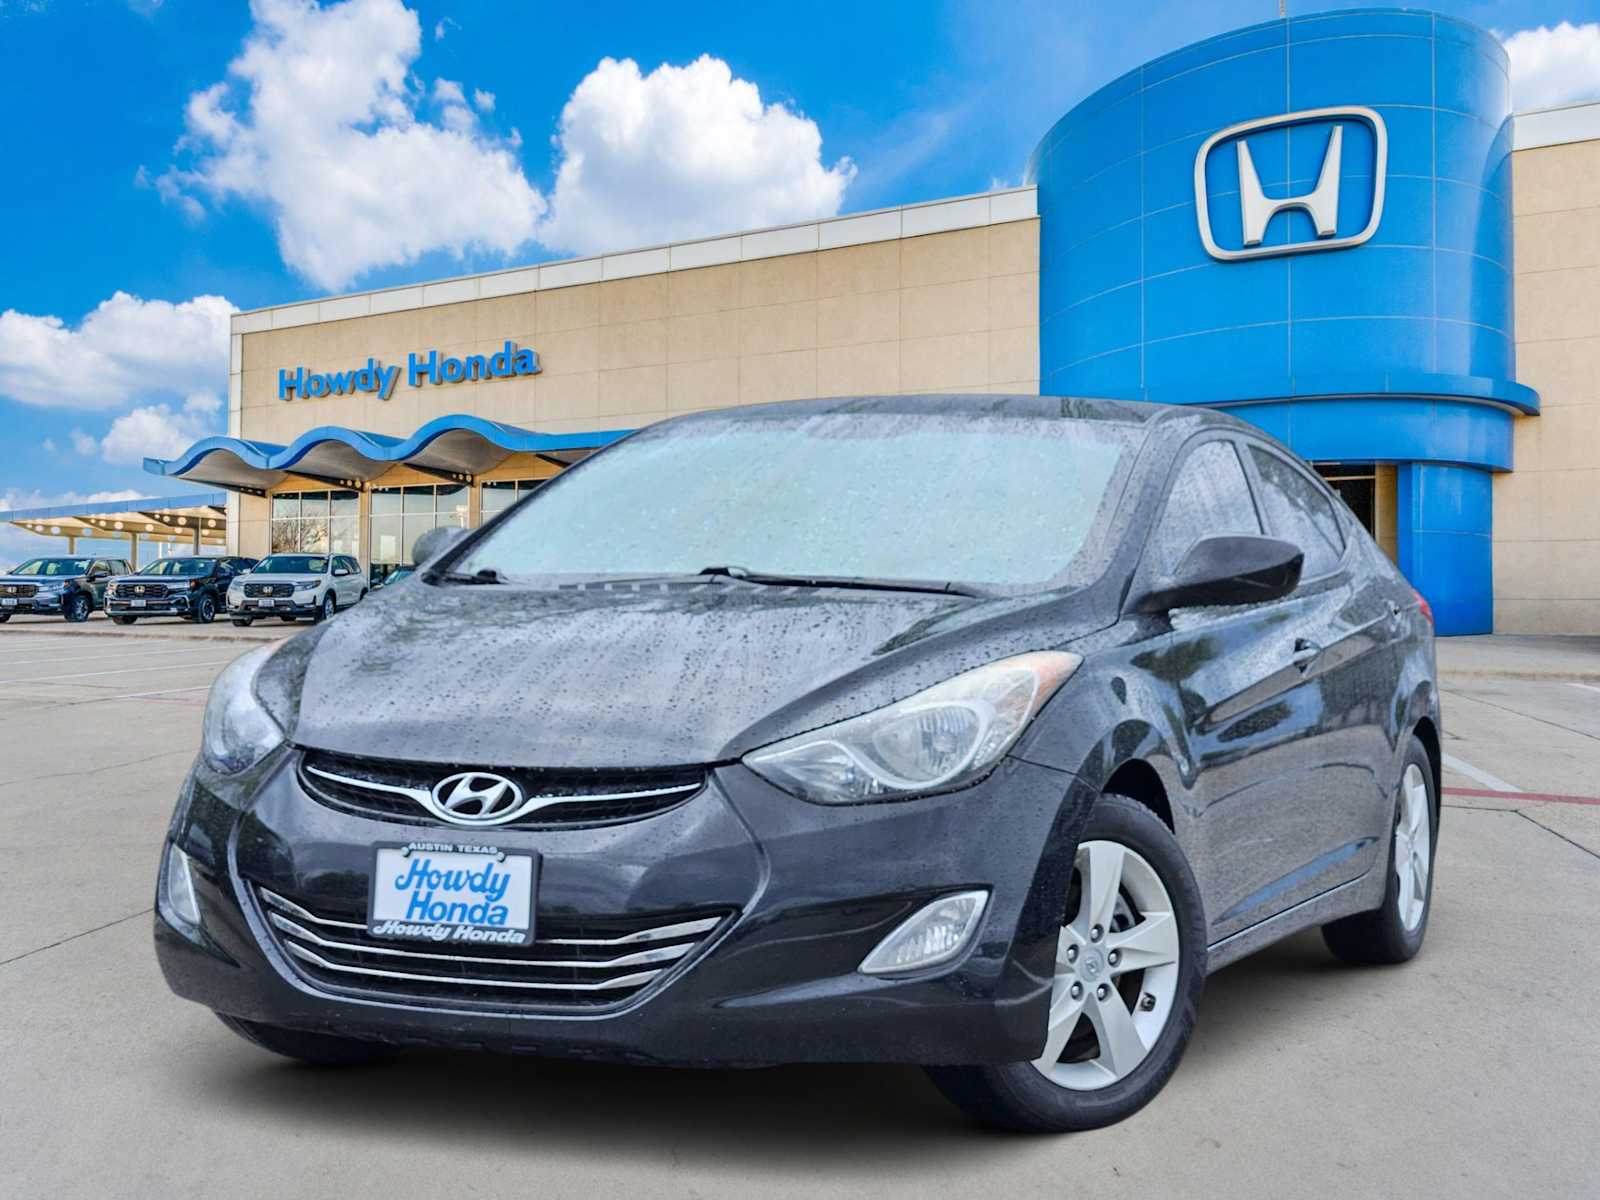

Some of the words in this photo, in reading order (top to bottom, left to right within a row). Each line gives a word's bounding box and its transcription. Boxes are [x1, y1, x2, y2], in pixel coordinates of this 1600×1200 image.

[278, 358, 401, 401] Howdy
[408, 340, 542, 388] Honda
[408, 842, 453, 852] AUSTIN
[458, 844, 498, 854] TEXAS
[395, 858, 511, 902] Howdy
[405, 891, 509, 925] Honda
[373, 920, 451, 941] Howdy
[452, 925, 526, 943] Honda
